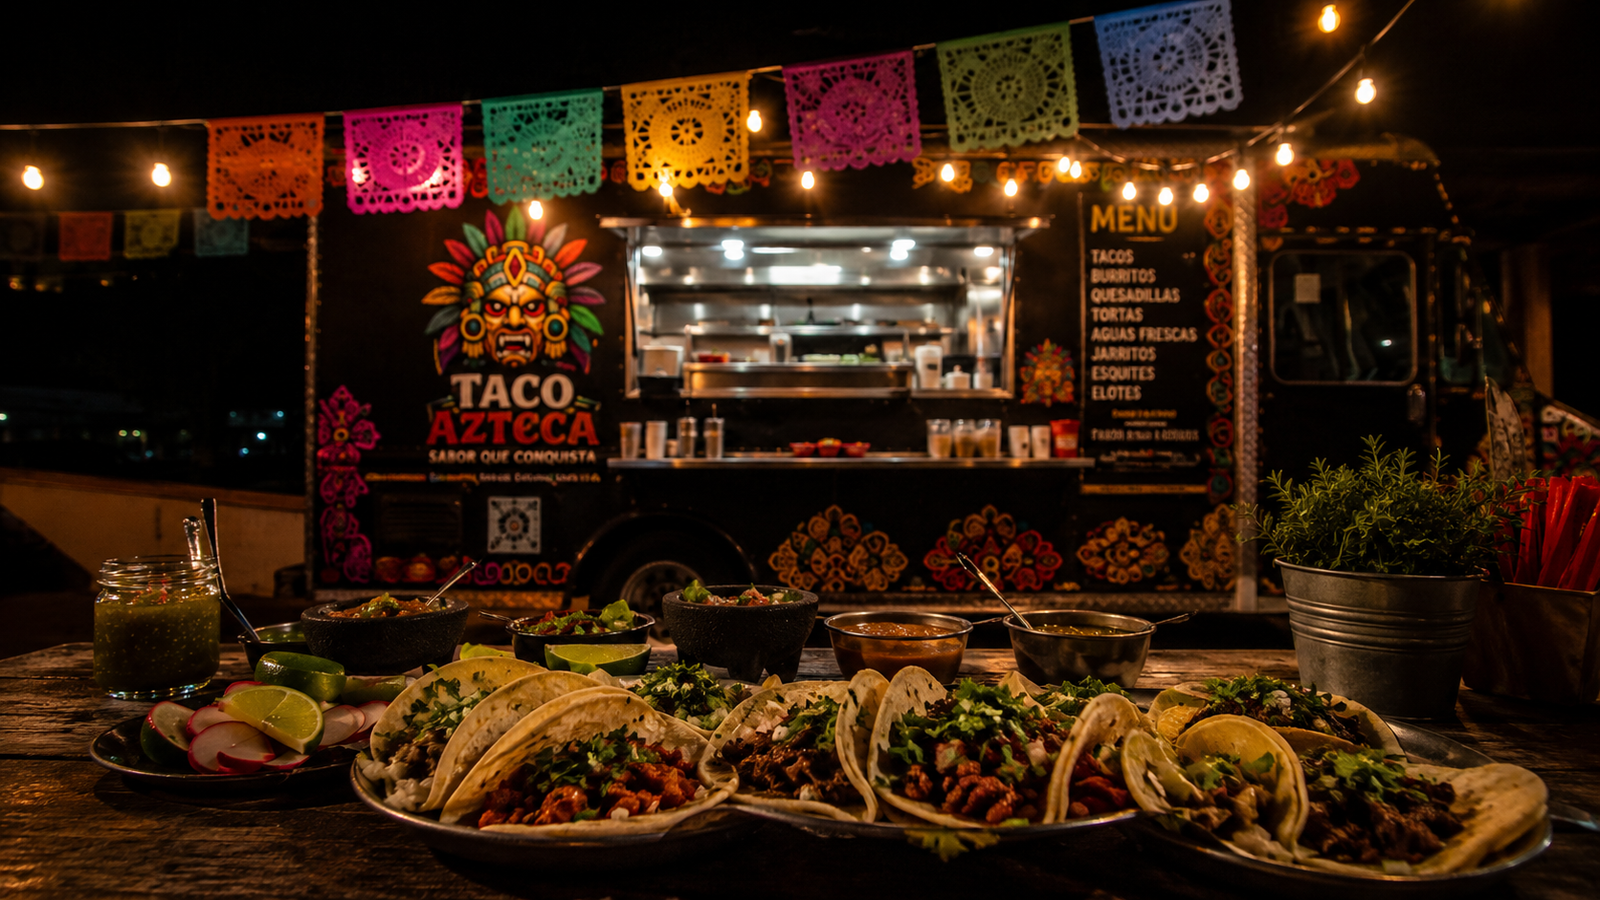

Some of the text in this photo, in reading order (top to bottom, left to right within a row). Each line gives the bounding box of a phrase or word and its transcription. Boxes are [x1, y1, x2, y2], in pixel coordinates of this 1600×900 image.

[1091, 204, 1178, 233] MENU
[1090, 248, 1134, 265] TACOS
[1091, 268, 1156, 284] BURRITOS
[1091, 287, 1180, 304] QUESADILLAS
[1091, 307, 1143, 322] TORTAS
[1091, 326, 1198, 342] AGUAS FRESCAS
[1091, 346, 1156, 362] JARRITOS
[1091, 366, 1155, 382] ESQUITES
[450, 373, 575, 409] TACO
[1091, 385, 1142, 400] ELOTES
[426, 410, 599, 446] AZTECA
[428, 450, 597, 466] SABOR QUE CONQUISTA
